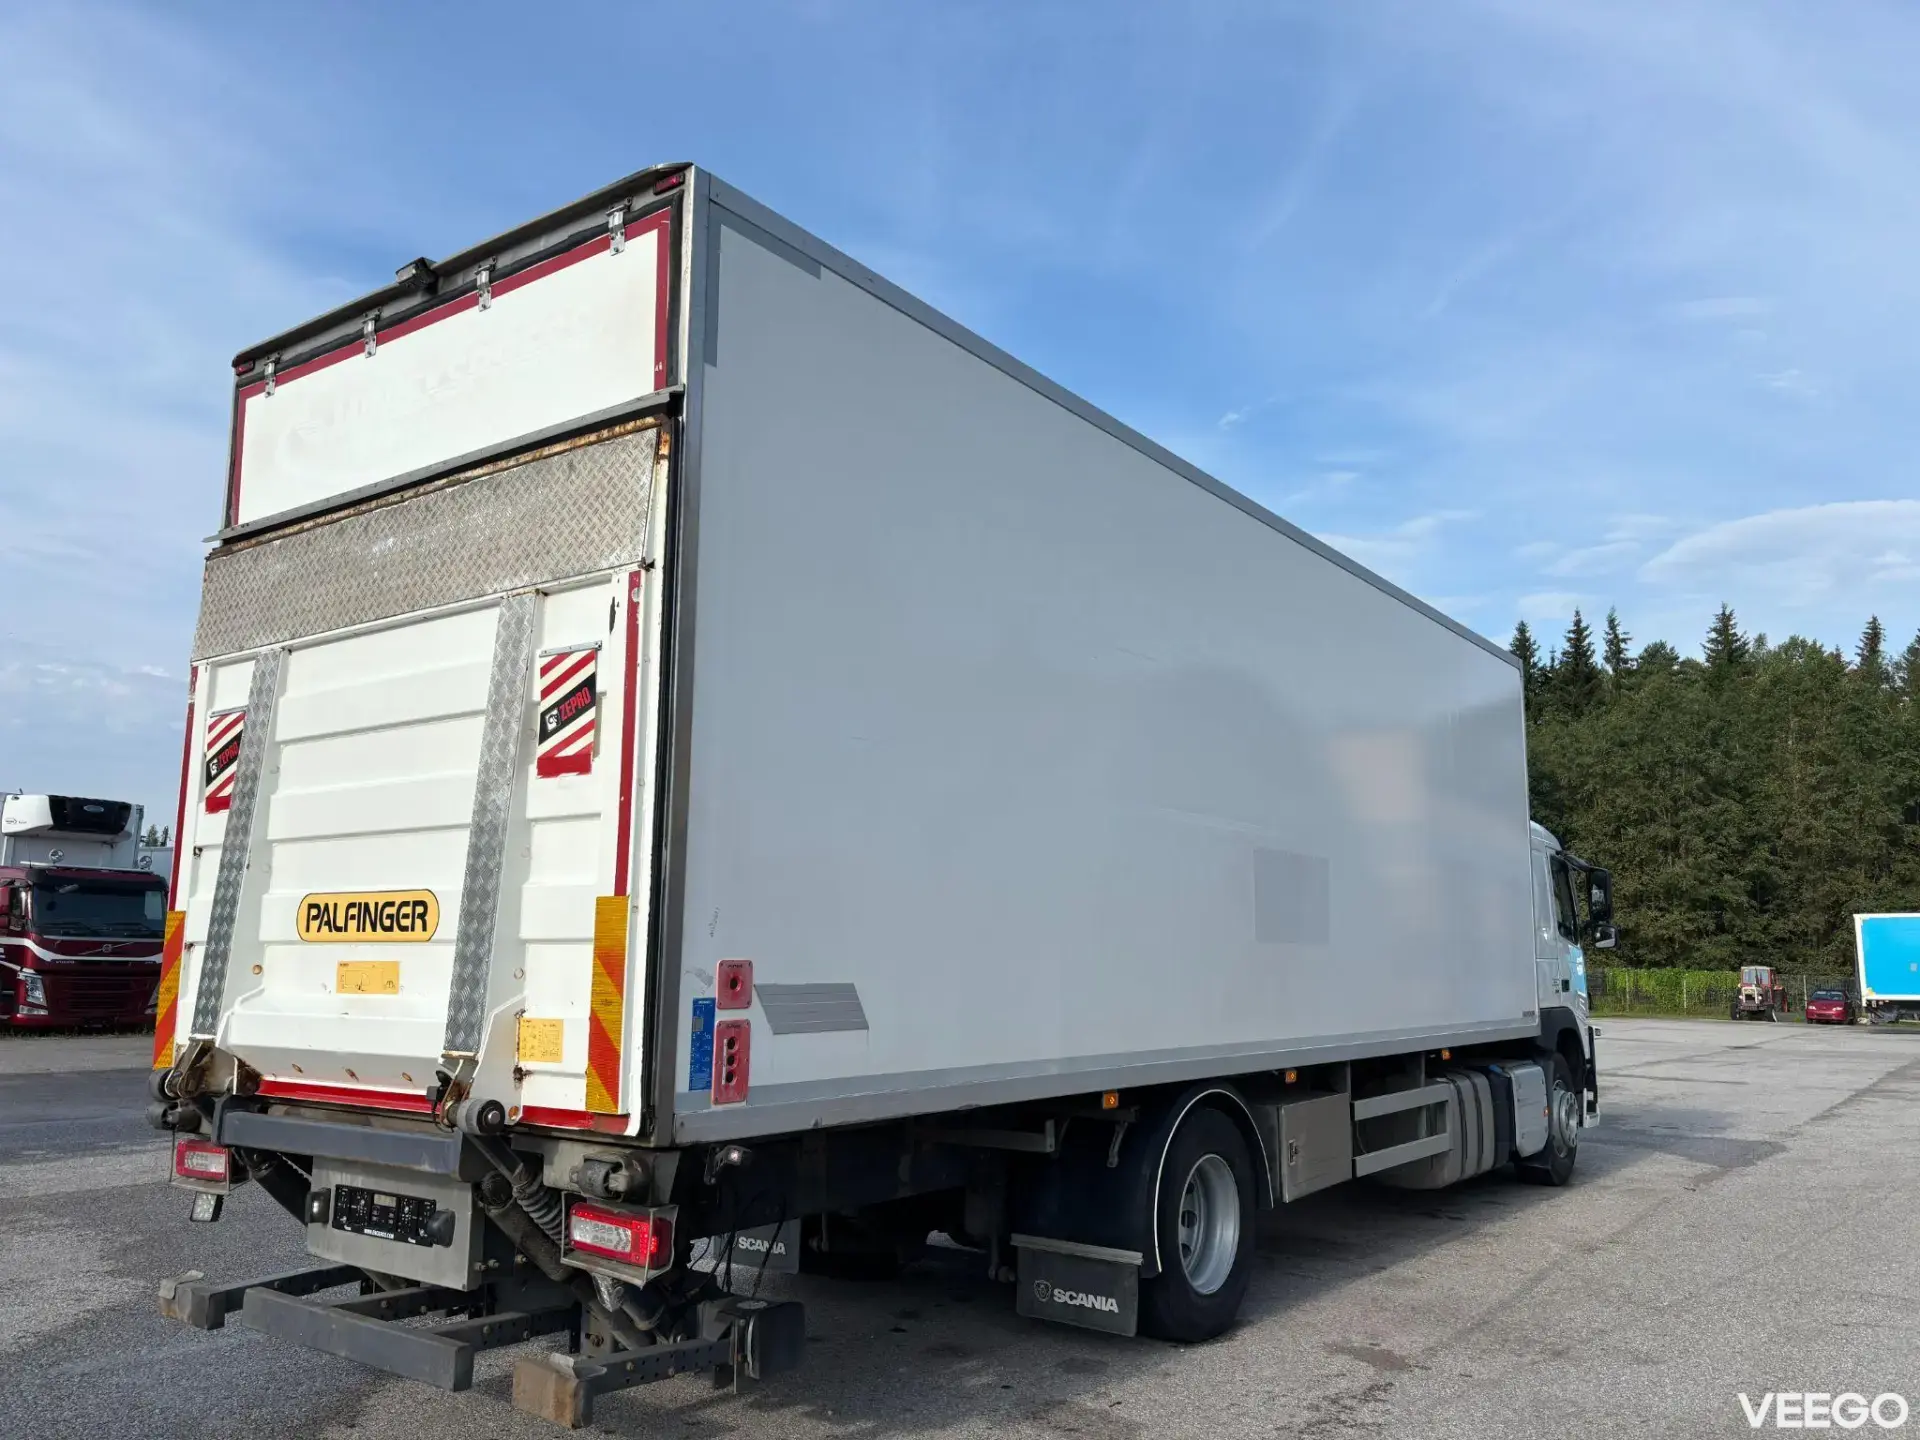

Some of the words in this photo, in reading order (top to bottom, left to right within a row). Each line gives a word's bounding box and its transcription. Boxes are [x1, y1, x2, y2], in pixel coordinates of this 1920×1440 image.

[559, 686, 592, 721] ZEPRO
[218, 742, 239, 769] ZEPRO
[305, 900, 429, 933] PALFINGER
[1053, 1288, 1119, 1314] SCANIA
